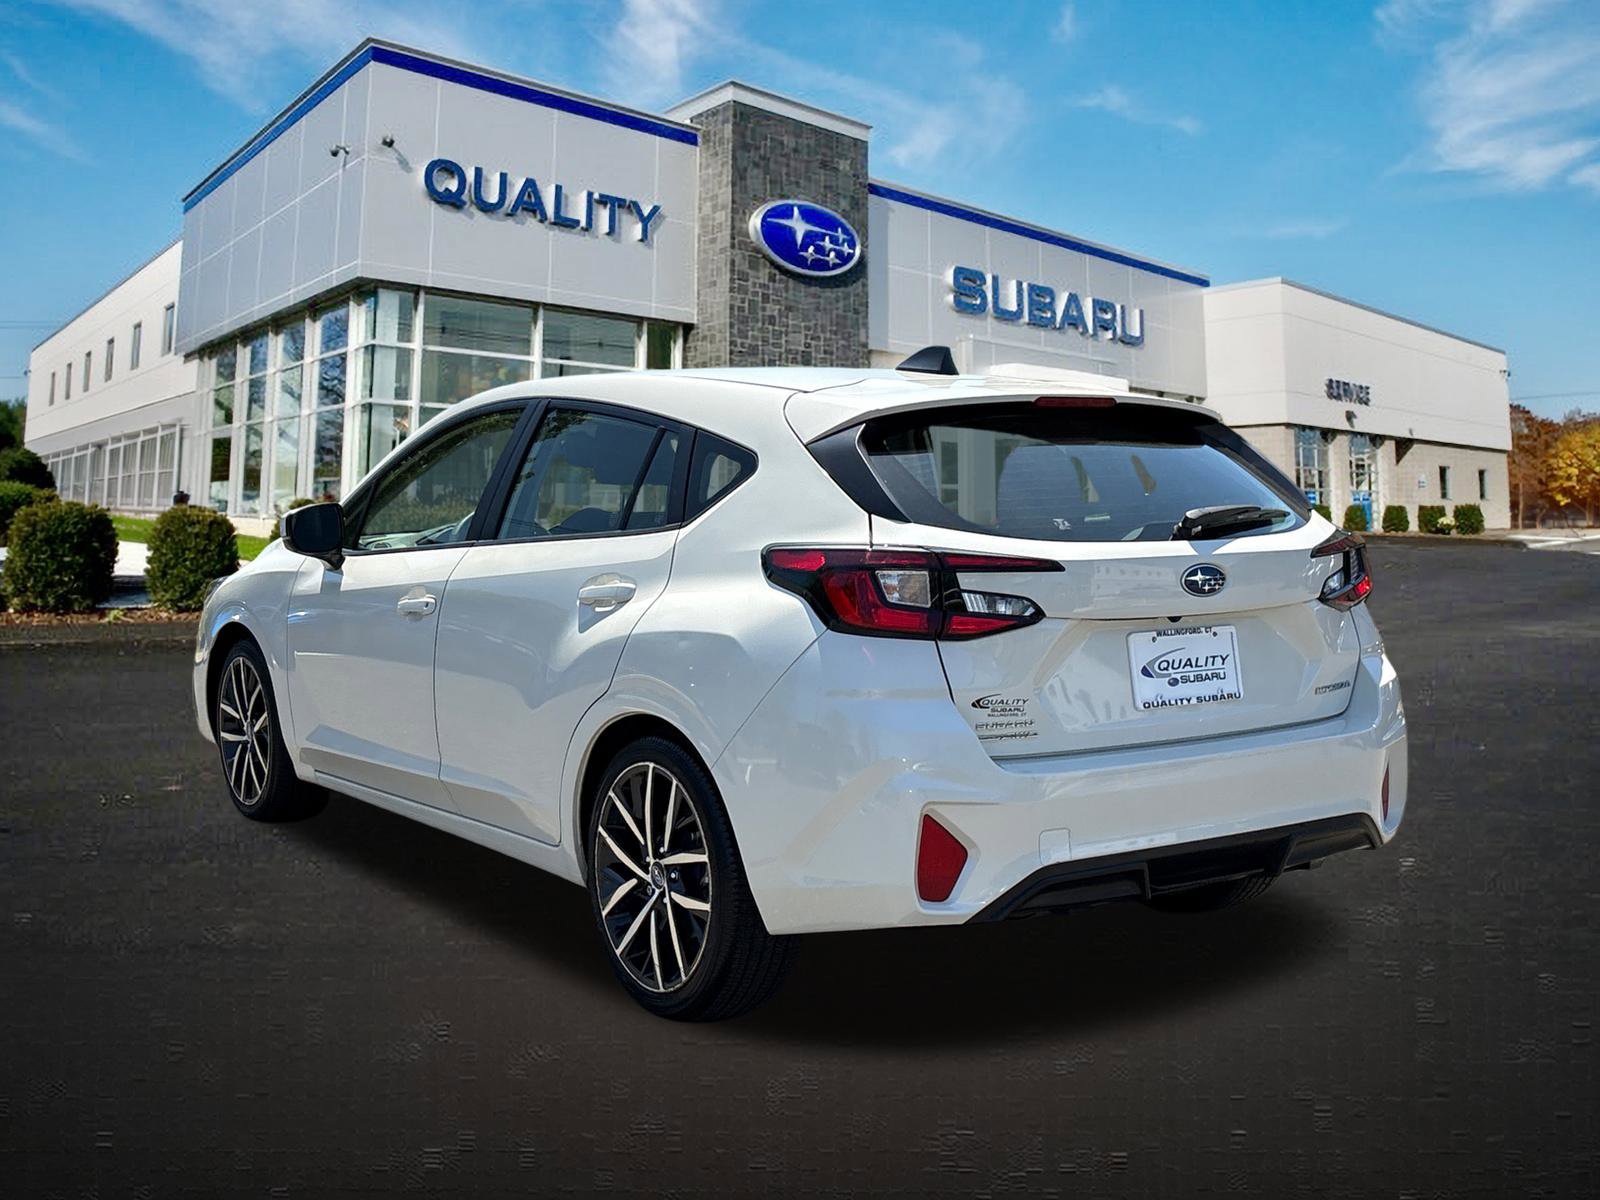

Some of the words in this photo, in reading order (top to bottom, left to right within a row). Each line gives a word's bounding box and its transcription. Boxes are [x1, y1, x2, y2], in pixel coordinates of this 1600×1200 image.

[424, 158, 661, 242] QUALITY
[949, 265, 1145, 346] SUBARU
[1325, 378, 1371, 406] SERVICE
[1157, 654, 1230, 672] QUALITY
[1179, 672, 1226, 684] SUBARU
[981, 698, 1029, 706] QUALITY
[1143, 697, 1192, 709] QUALITY
[1196, 692, 1241, 704] SUBARU
